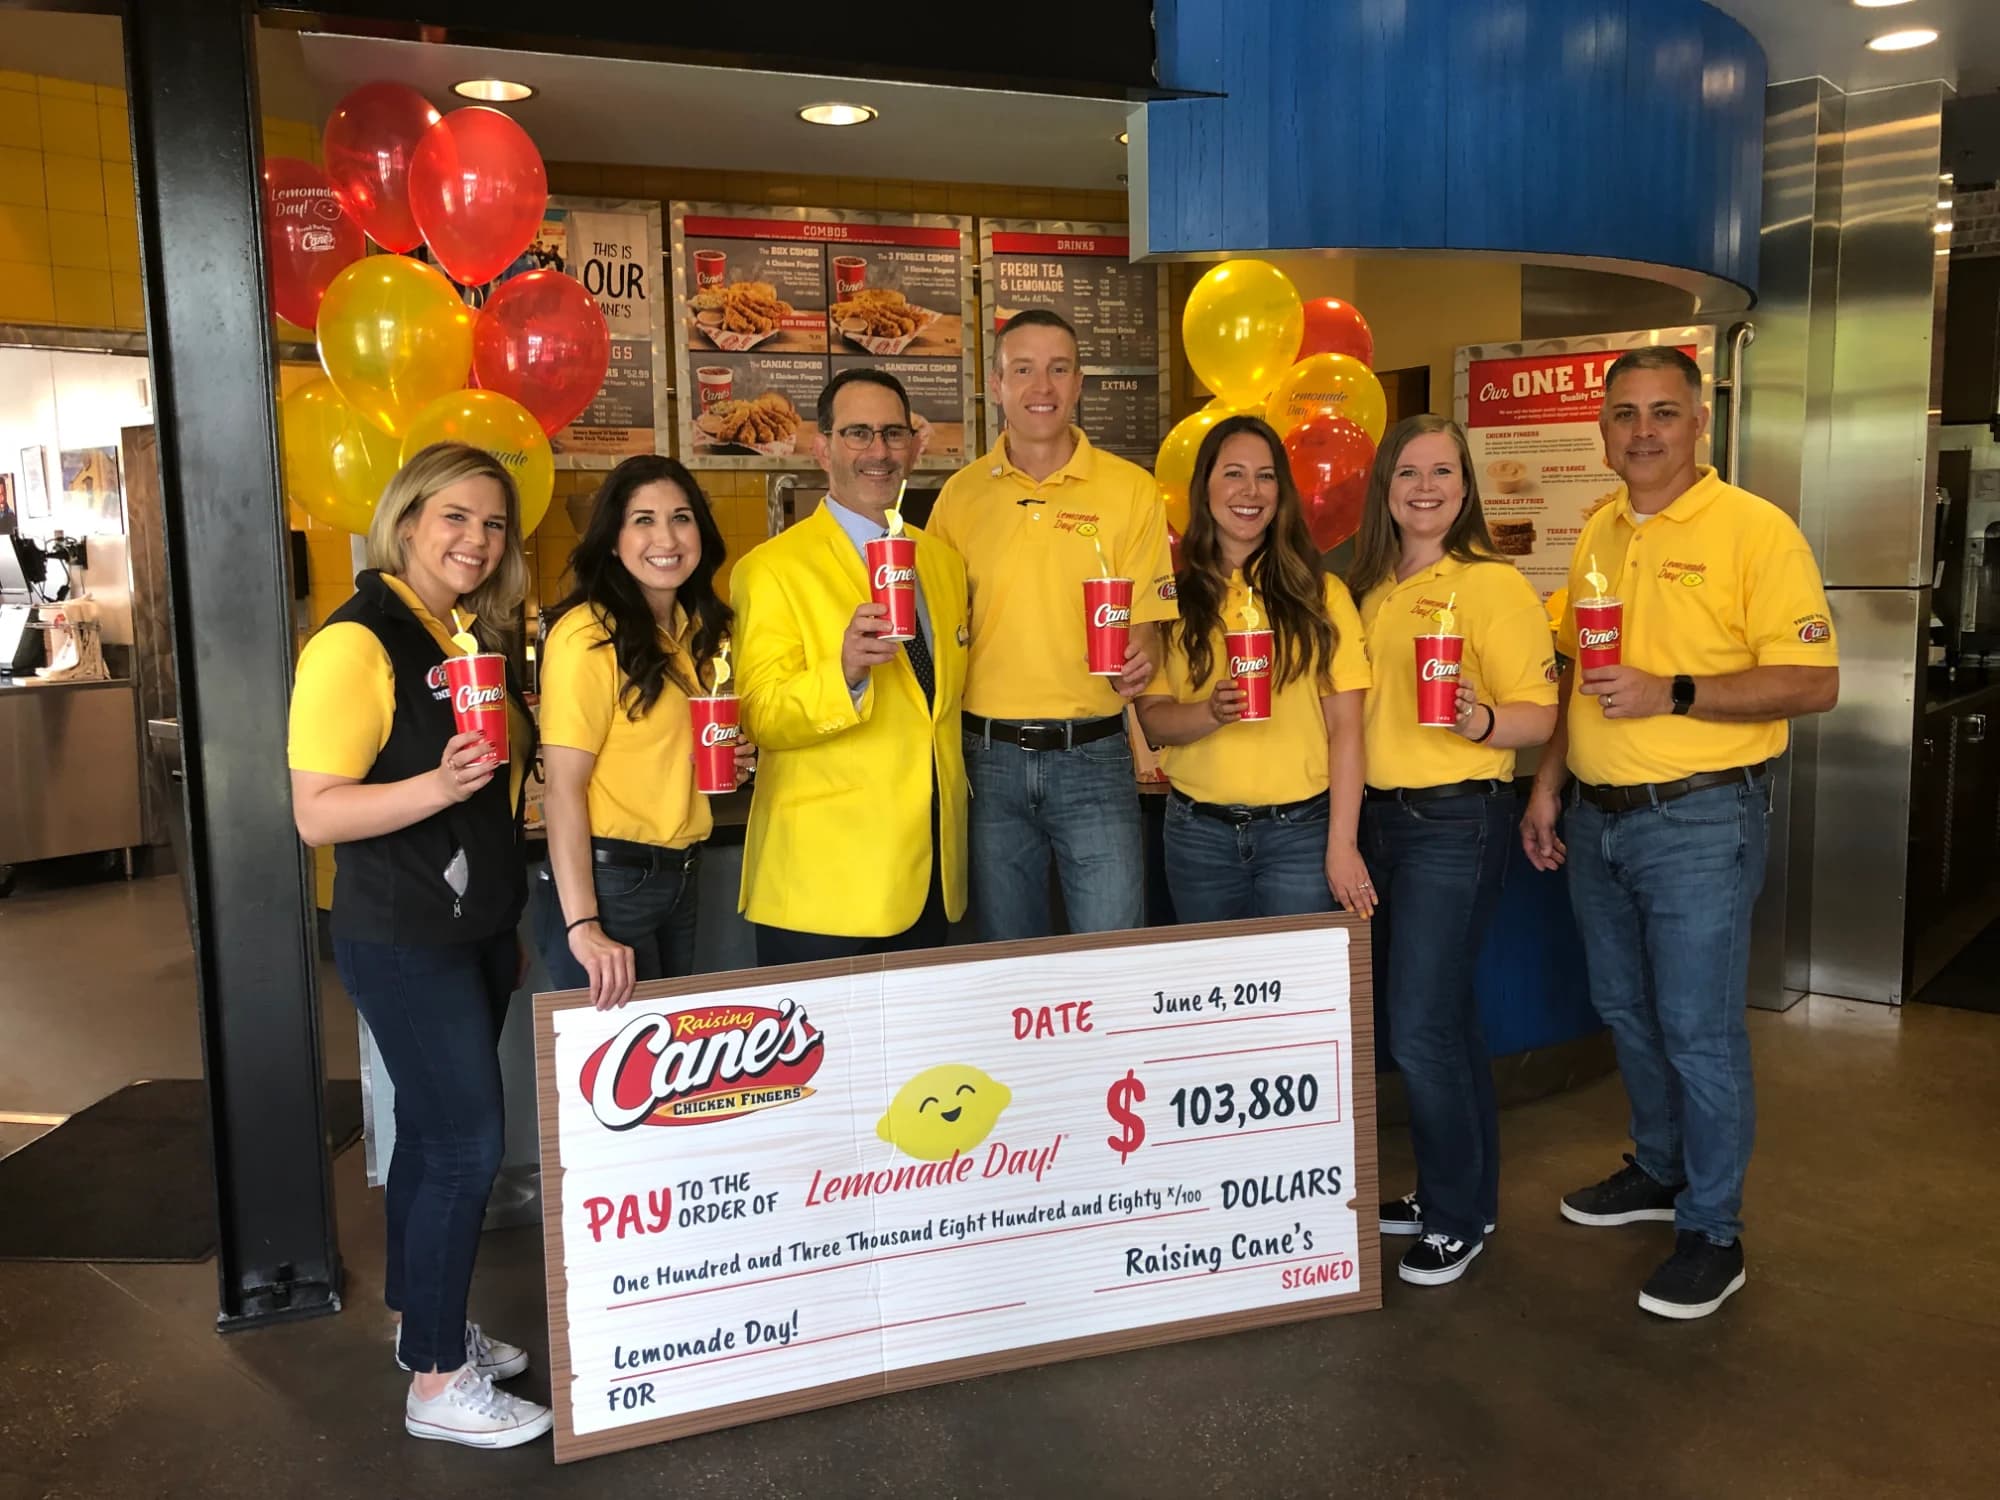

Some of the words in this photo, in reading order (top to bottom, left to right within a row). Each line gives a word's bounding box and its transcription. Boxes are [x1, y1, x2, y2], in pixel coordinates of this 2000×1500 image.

[276, 200, 308, 218] Day!
[803, 225, 848, 238] COMBOS
[1057, 240, 1095, 251] DRINKS
[592, 242, 618, 258] THIS
[621, 246, 632, 259] IS
[583, 258, 646, 300] OUR
[1000, 262, 1038, 278] FRESH
[1041, 264, 1064, 278] TEA
[1000, 280, 1008, 292] &
[1010, 280, 1065, 293] LEMONADE
[599, 304, 632, 319] ANE'S
[760, 359, 792, 369] CANIAC
[1101, 381, 1138, 392] EXTRAS
[1479, 381, 1510, 402] Our
[1513, 365, 1575, 398] ONE
[1094, 602, 1130, 628] Cane
[1578, 625, 1620, 649] Cane's
[1230, 654, 1269, 678] Cane's
[1422, 658, 1461, 681] Cane
[455, 682, 505, 713] Cane's
[701, 721, 740, 747] Cane
[1152, 990, 1203, 1015] June
[1207, 986, 1227, 1010] 4,
[1233, 980, 1282, 1006] 2019
[675, 1008, 755, 1038] Raising
[1012, 1000, 1094, 1040] DATE
[592, 998, 825, 1132] Cane's
[672, 1097, 736, 1117] CHICKEN
[740, 1087, 801, 1106] FINGERS
[1106, 1068, 1146, 1165] $
[1169, 1073, 1319, 1128] 103,880
[805, 1148, 975, 1208] Lemonade
[981, 1134, 1061, 1183] Day!
[583, 1187, 673, 1243] PAY
[676, 1179, 702, 1202] TO
[709, 1171, 751, 1196] THE
[678, 1197, 747, 1228] ORDER
[752, 1192, 779, 1215] OF
[612, 1274, 650, 1295] One
[656, 1253, 742, 1287] Hundred
[747, 1246, 783, 1270] and
[788, 1240, 842, 1263] Three
[846, 1219, 933, 1252] Thousand
[938, 1212, 987, 1240] Eight
[991, 1200, 1067, 1229] Hundred
[1071, 1193, 1102, 1218] and
[1108, 1188, 1162, 1213] Eighty
[1220, 1165, 1343, 1211] DOLLARS
[1125, 1243, 1223, 1277] Raising
[1231, 1222, 1314, 1260] Cane's
[1281, 1258, 1354, 1290] SIGNED
[614, 1328, 736, 1370] Lemonade
[744, 1309, 800, 1346] Day!
[606, 1382, 656, 1412] FOR
